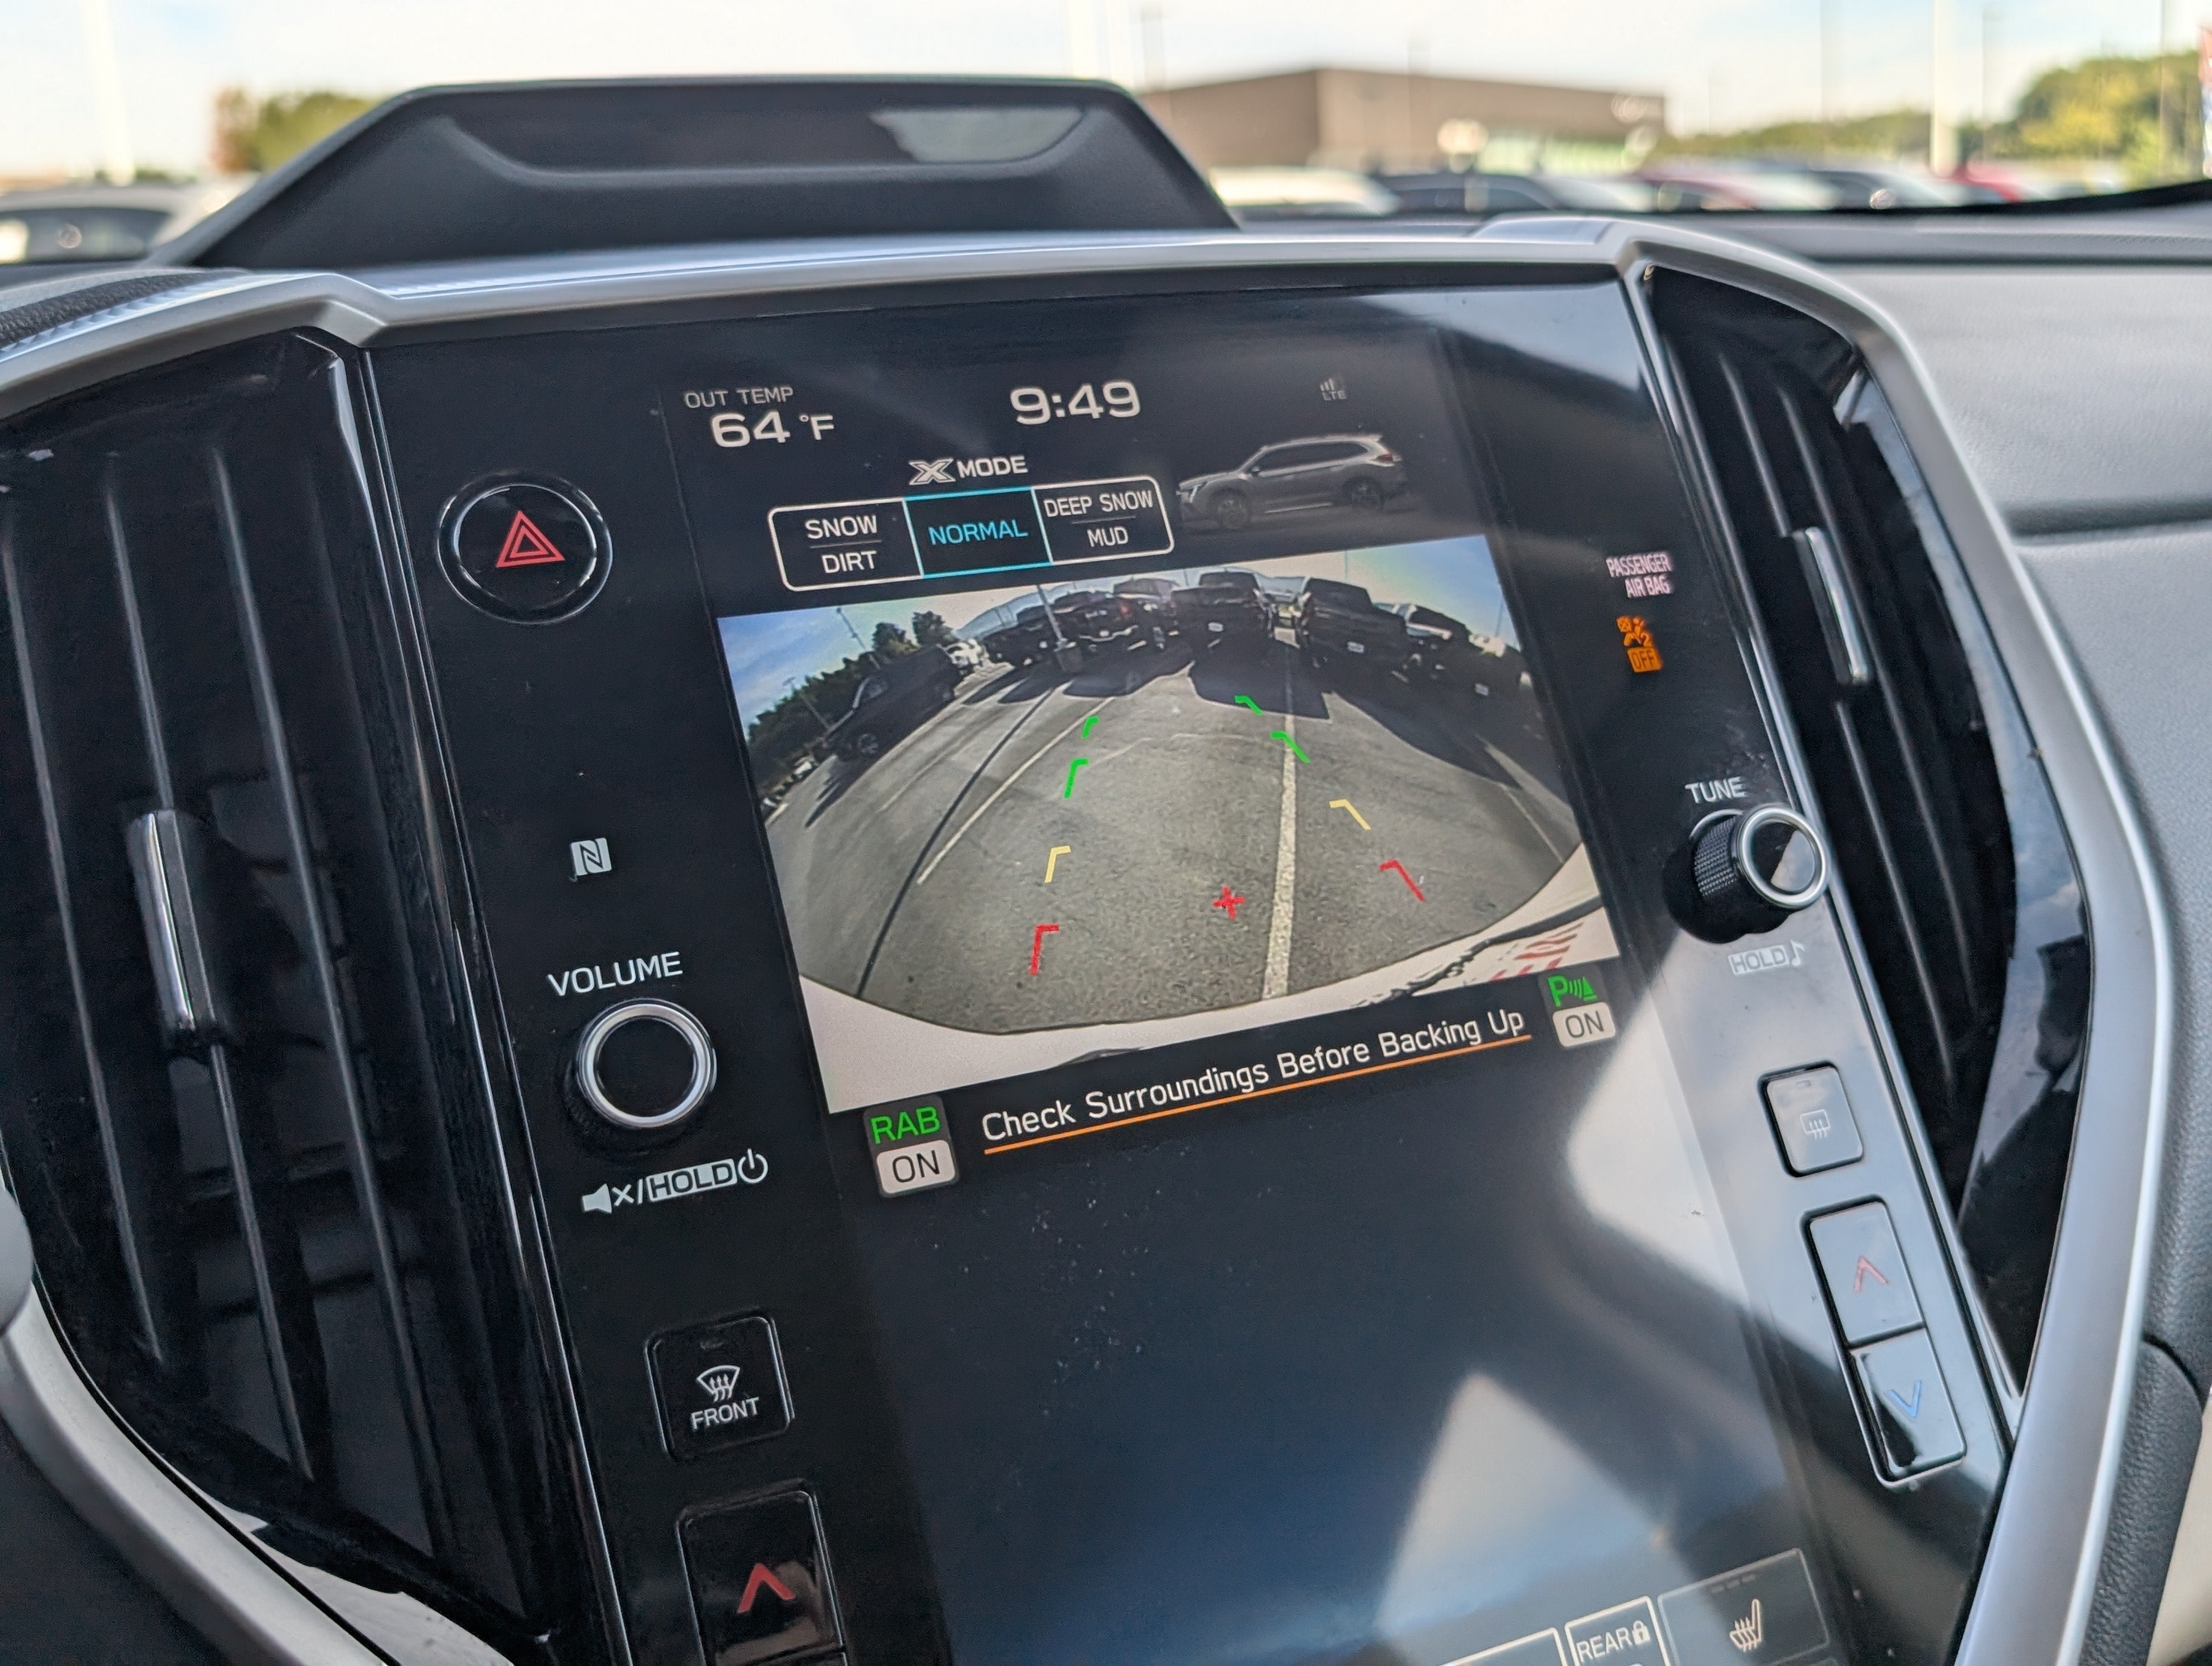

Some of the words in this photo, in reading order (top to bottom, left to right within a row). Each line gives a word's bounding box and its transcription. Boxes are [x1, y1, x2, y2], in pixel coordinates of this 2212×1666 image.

[684, 390, 728, 409] OUT
[736, 386, 794, 405] TEMP
[1009, 381, 1141, 425] 9:49
[710, 411, 790, 448] 64
[956, 456, 1028, 478] MODE
[1044, 497, 1092, 519] DEEP
[1099, 489, 1154, 512] SNOW
[805, 515, 878, 539] SNOW
[928, 519, 1028, 545] NORMAL
[1086, 526, 1129, 548] MUD
[822, 551, 877, 574] DIRT
[1606, 552, 1672, 578] PASSENGER
[1625, 576, 1647, 598] AIR
[1644, 574, 1671, 595] BAG
[1631, 649, 1657, 670] OFF
[1684, 777, 1746, 804] TUNE
[1733, 946, 1789, 972] HOLD
[548, 951, 683, 997] VOLUME
[1565, 1014, 1604, 1040] ON
[982, 1100, 1076, 1141] Check
[1085, 1063, 1269, 1118] Surroundings
[1276, 1042, 1370, 1079] Before
[1378, 1018, 1481, 1058] Backing
[1487, 1009, 1525, 1036] Up
[871, 1105, 941, 1144] RAB
[891, 1150, 940, 1183] ON
[690, 1397, 760, 1431] FRONT
[1576, 1627, 1632, 1663] REAR
